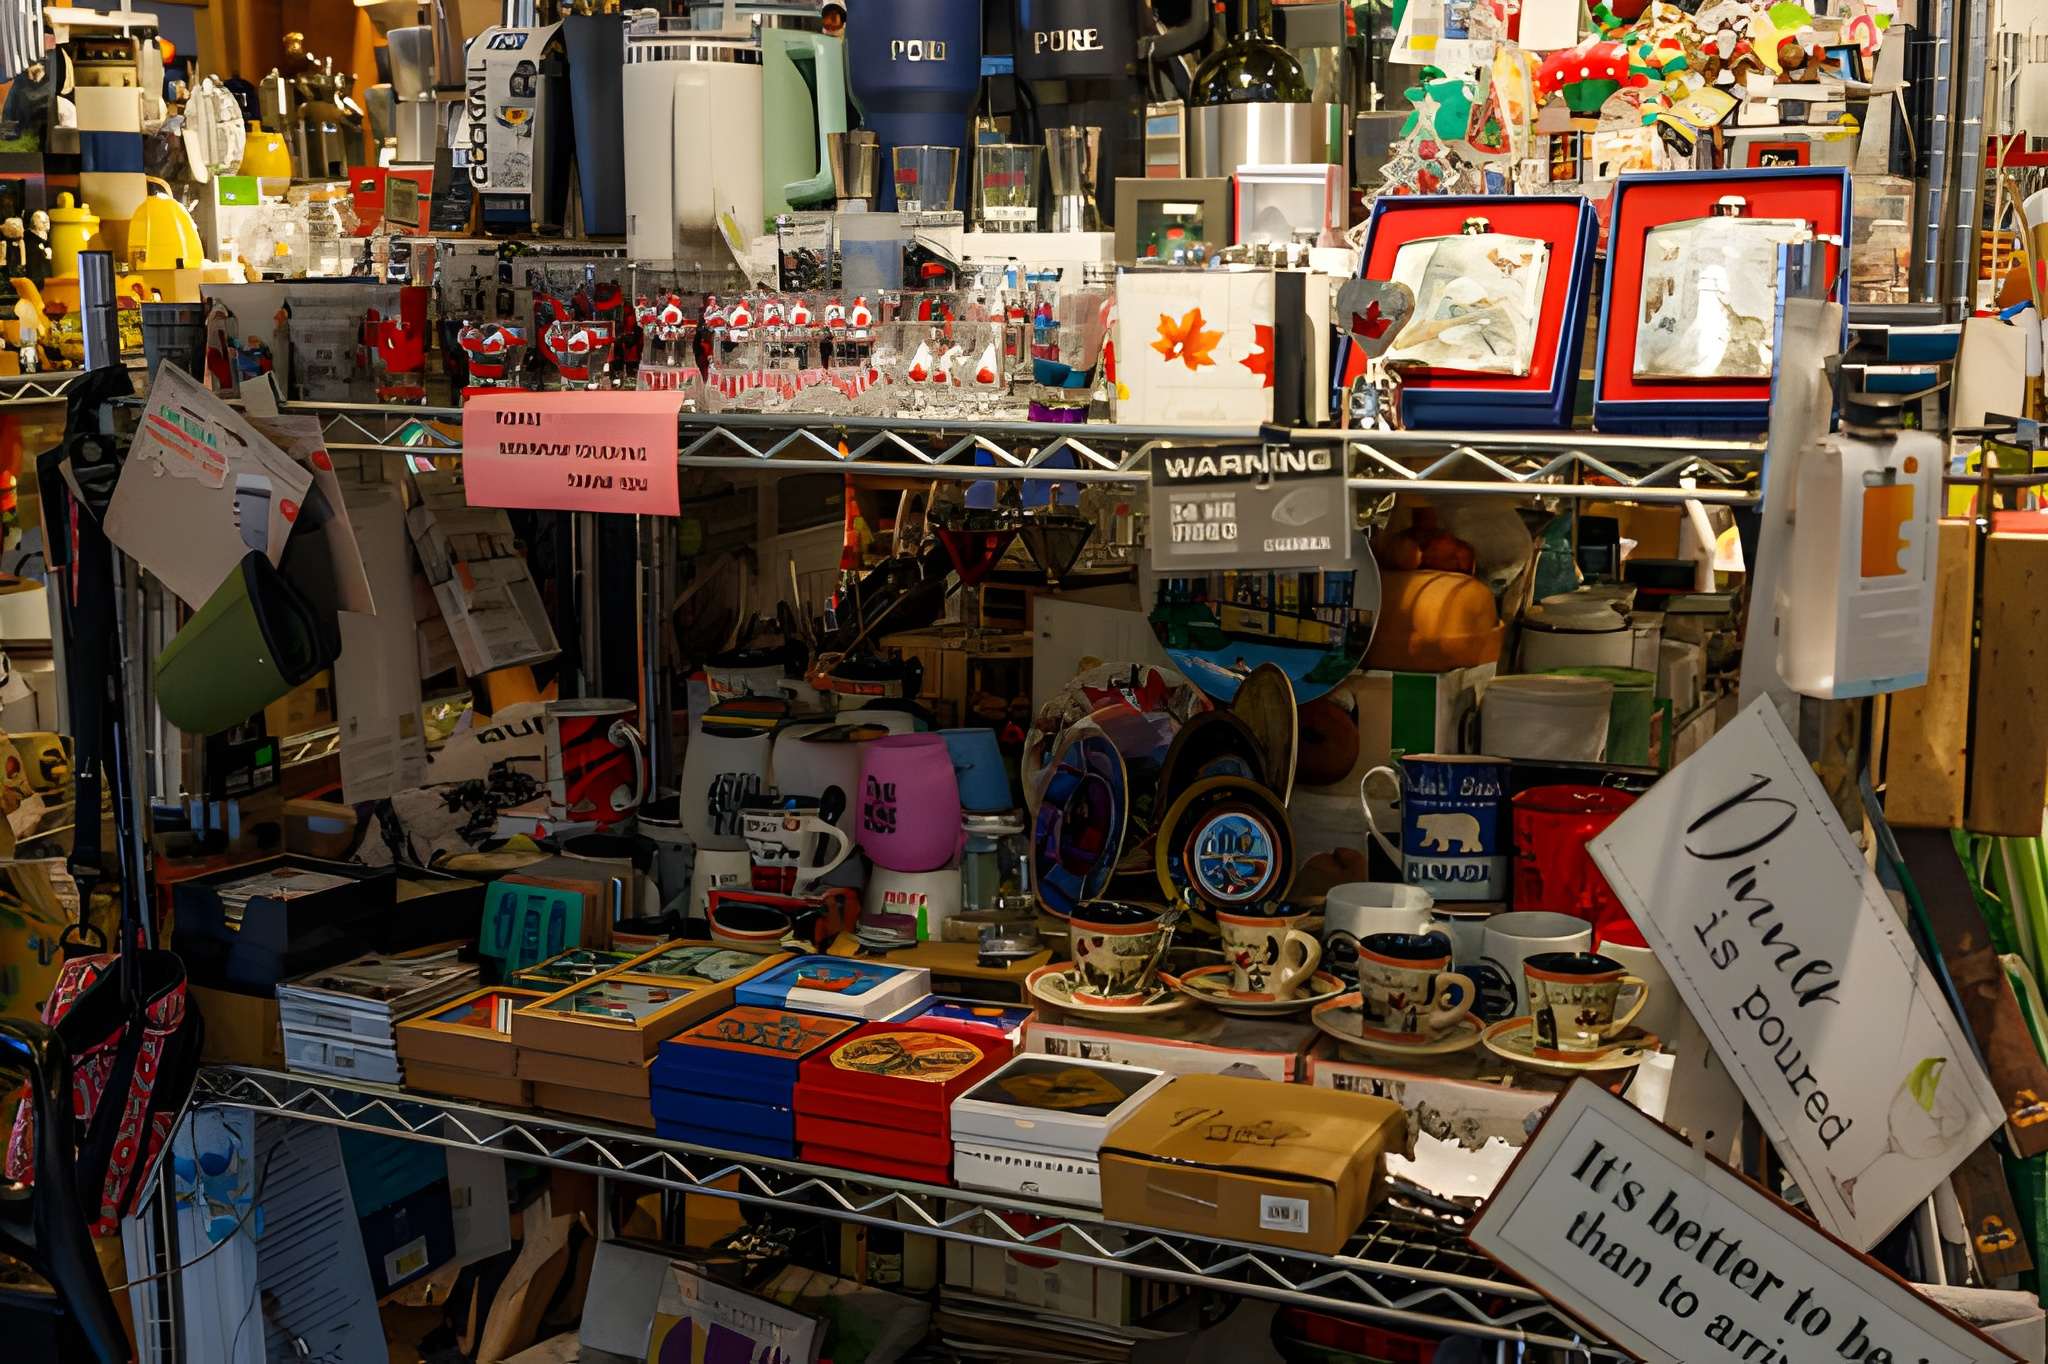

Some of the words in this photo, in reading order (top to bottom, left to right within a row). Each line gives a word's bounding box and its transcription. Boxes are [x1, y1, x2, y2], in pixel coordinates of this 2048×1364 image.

[1164, 449, 1332, 478] WARNING
[1685, 773, 1840, 1008] Dinner
[1694, 909, 1740, 970] is
[1732, 984, 1853, 1151] poured
[1565, 1210, 1652, 1288] than
[1658, 1274, 1699, 1319] to
[1570, 1139, 1645, 1213] It's
[1646, 1190, 1784, 1302] better
[1783, 1286, 1832, 1337] to
